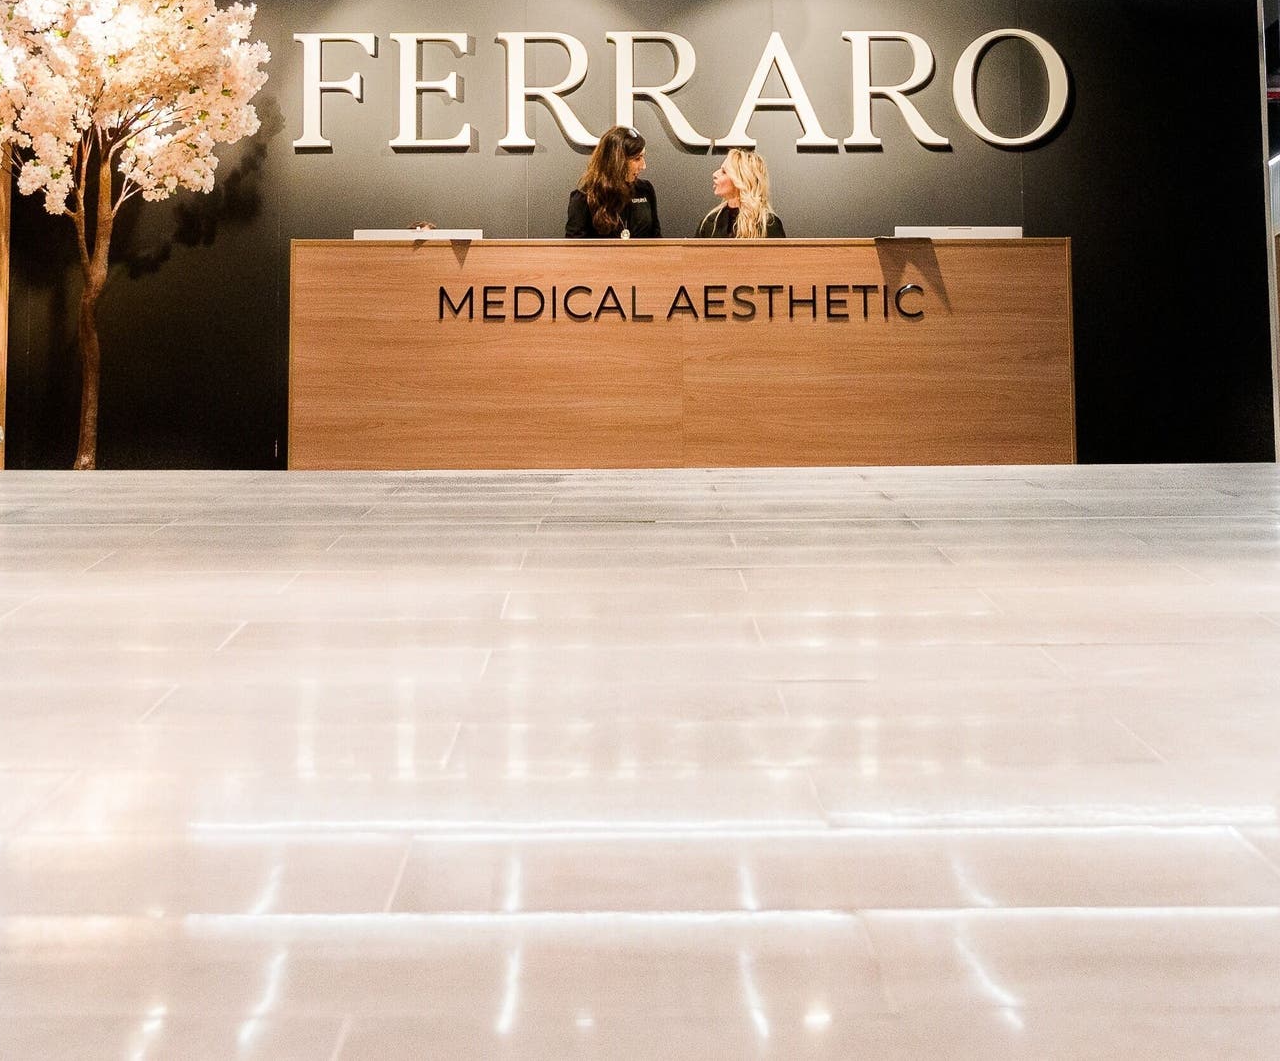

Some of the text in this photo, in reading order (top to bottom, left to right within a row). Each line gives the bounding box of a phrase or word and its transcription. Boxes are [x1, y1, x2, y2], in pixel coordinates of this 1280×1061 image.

[292, 28, 1069, 150] FERRARO
[438, 284, 925, 321] MEDICAL AESTHETIC
